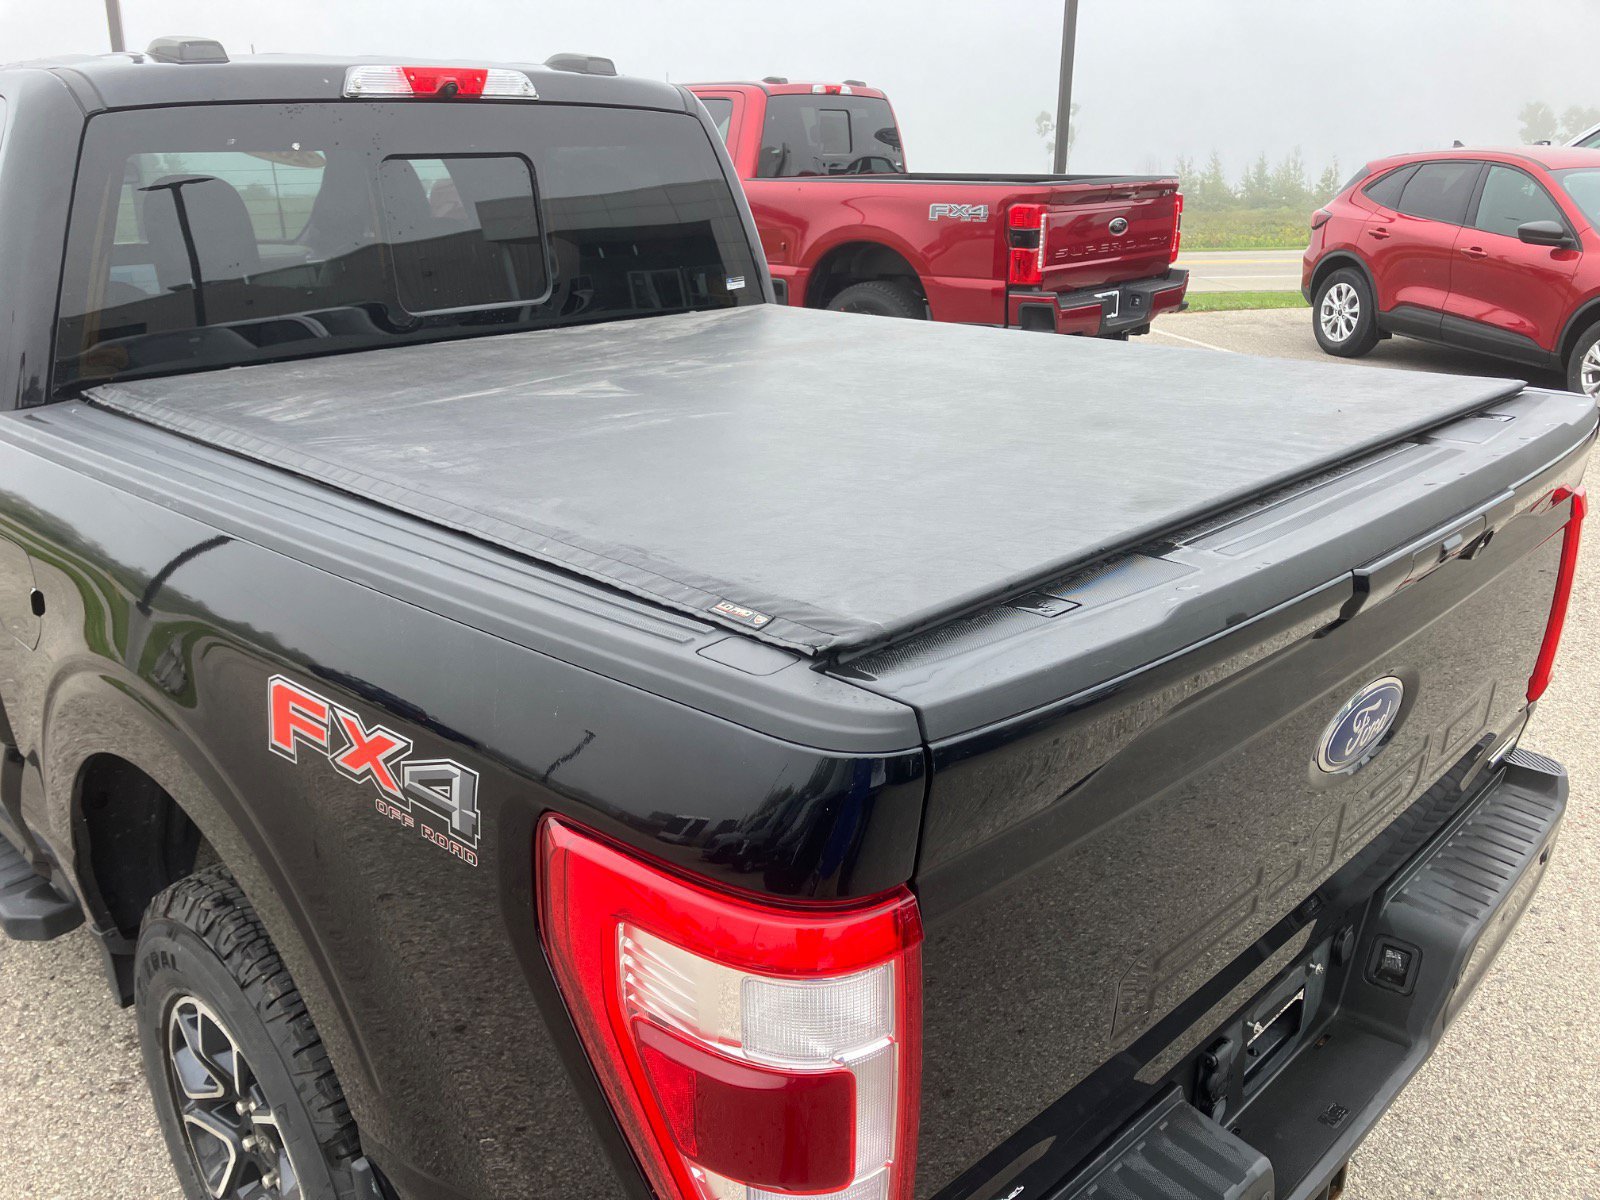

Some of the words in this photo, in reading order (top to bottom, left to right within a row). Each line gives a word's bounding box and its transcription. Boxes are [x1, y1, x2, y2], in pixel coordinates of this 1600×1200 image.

[928, 203, 989, 221] FX4
[1055, 242, 1122, 258] SUPER
[1344, 698, 1392, 757] Ford
[268, 674, 481, 850] FX4
[375, 798, 415, 828] OFF
[420, 823, 479, 867] ROAD
[1109, 682, 1499, 1042] F-150
